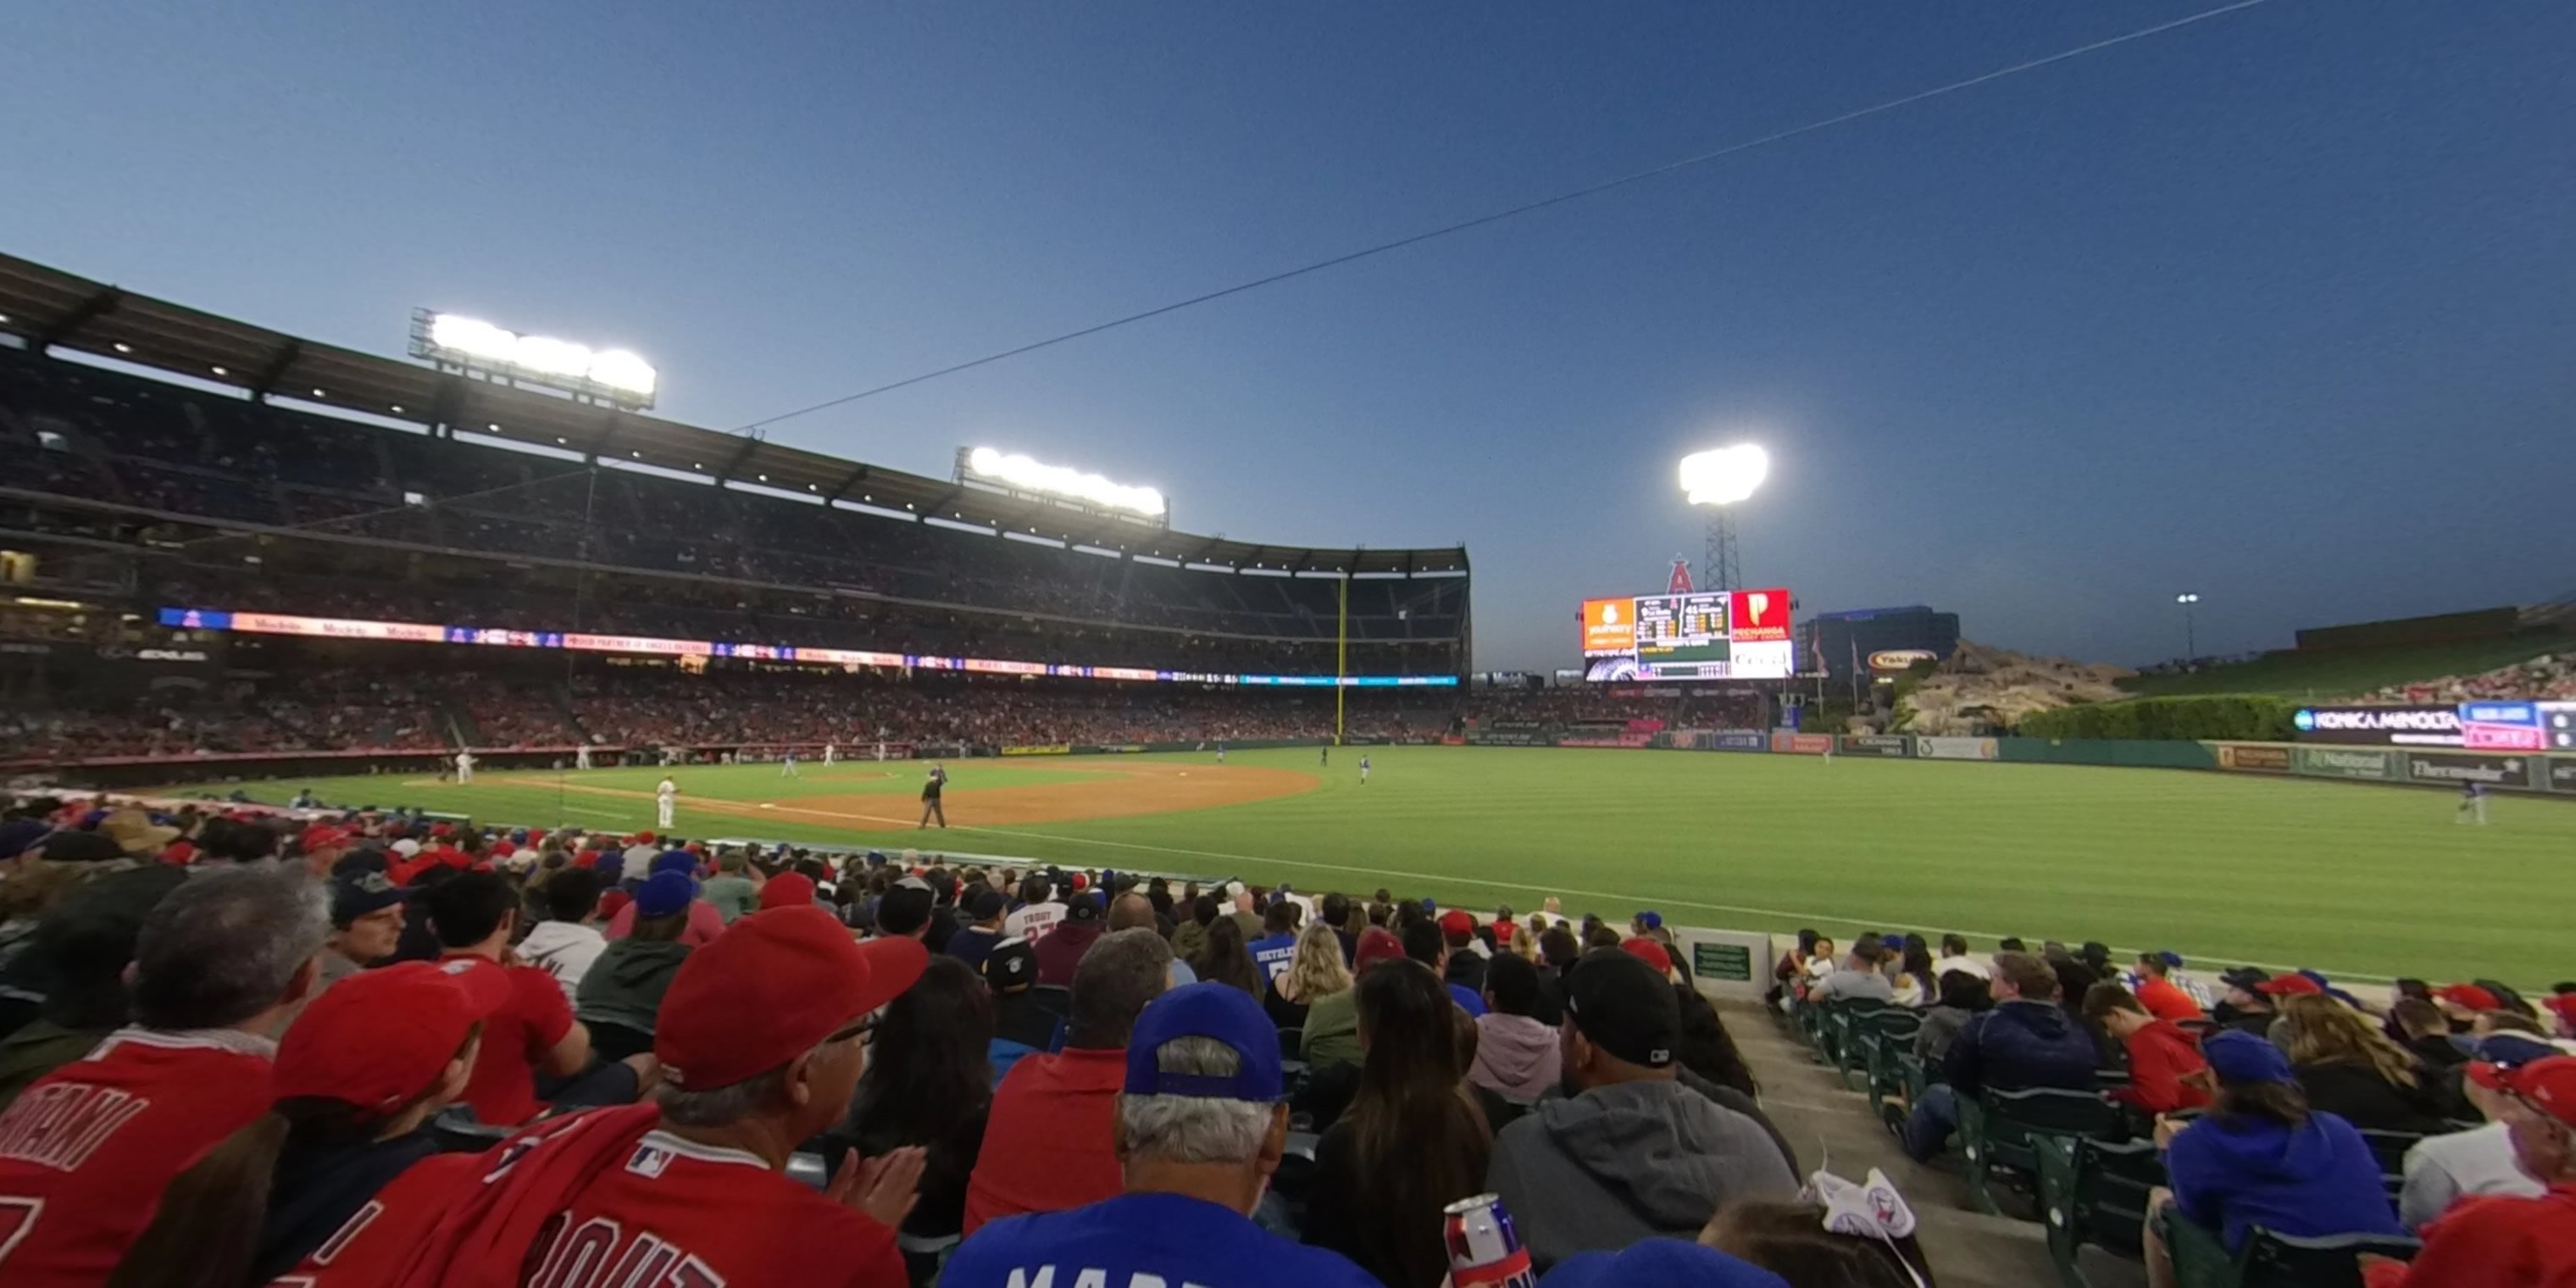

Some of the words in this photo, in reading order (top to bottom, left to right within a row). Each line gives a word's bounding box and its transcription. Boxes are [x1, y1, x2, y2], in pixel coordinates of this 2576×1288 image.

[2314, 711, 2379, 730] KONICA
[2379, 711, 2462, 730] MINOLTA
[1023, 911, 1052, 925] TROUT
